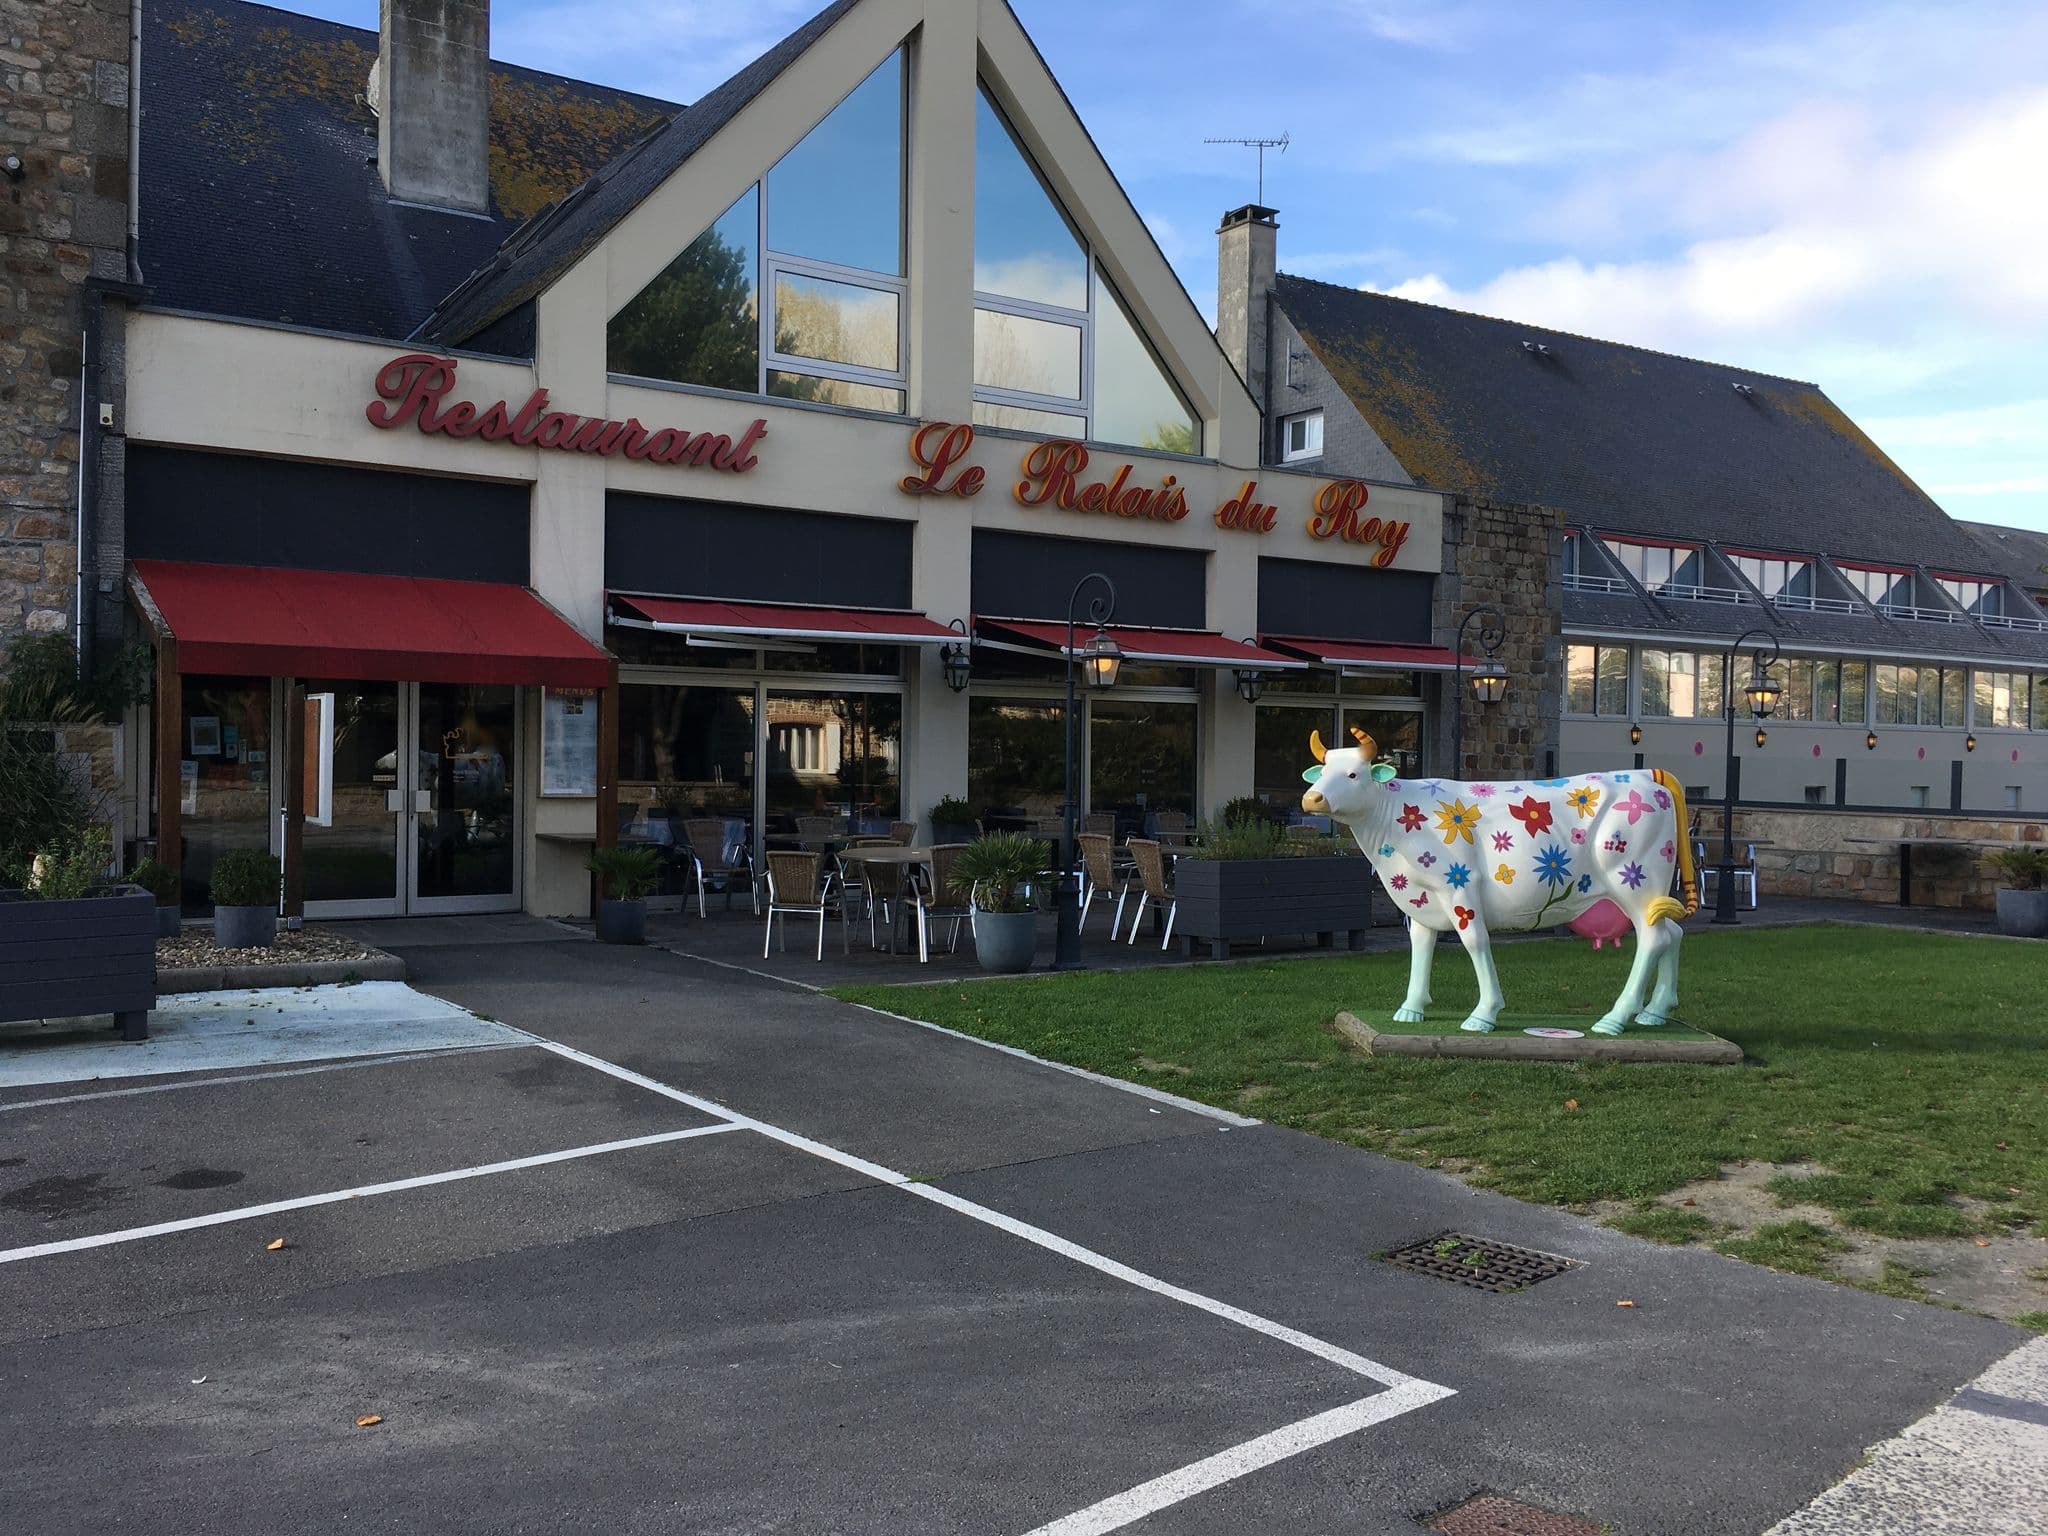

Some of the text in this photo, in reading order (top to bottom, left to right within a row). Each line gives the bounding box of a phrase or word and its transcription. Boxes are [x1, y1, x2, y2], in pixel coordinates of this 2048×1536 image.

[366, 354, 768, 472] Restaurant
[899, 422, 1410, 568] Le Relais du Roy
[554, 687, 594, 696] MENUS
